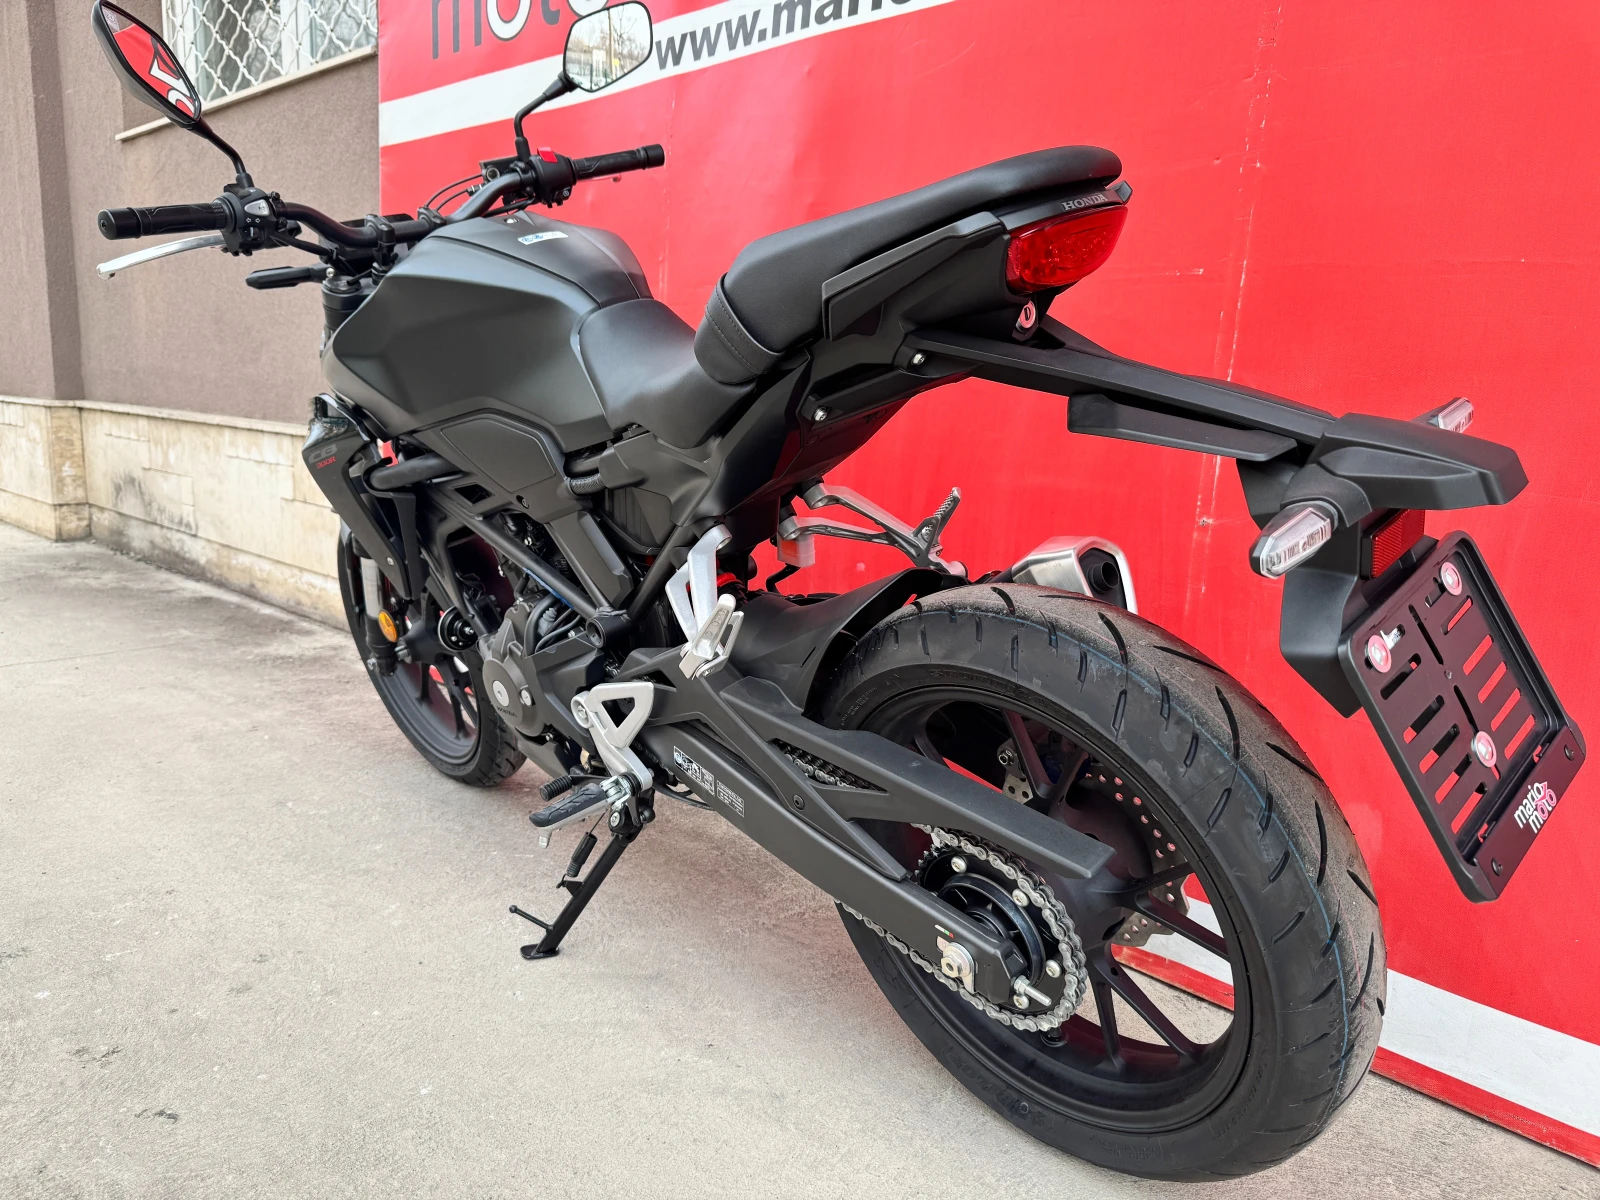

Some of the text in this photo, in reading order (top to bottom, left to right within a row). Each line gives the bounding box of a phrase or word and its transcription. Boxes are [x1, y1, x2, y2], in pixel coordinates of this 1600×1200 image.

[1061, 194, 1108, 211] HONDA
[308, 444, 338, 464] CB
[1513, 782, 1545, 829] mario
[1528, 788, 1557, 834] moto
